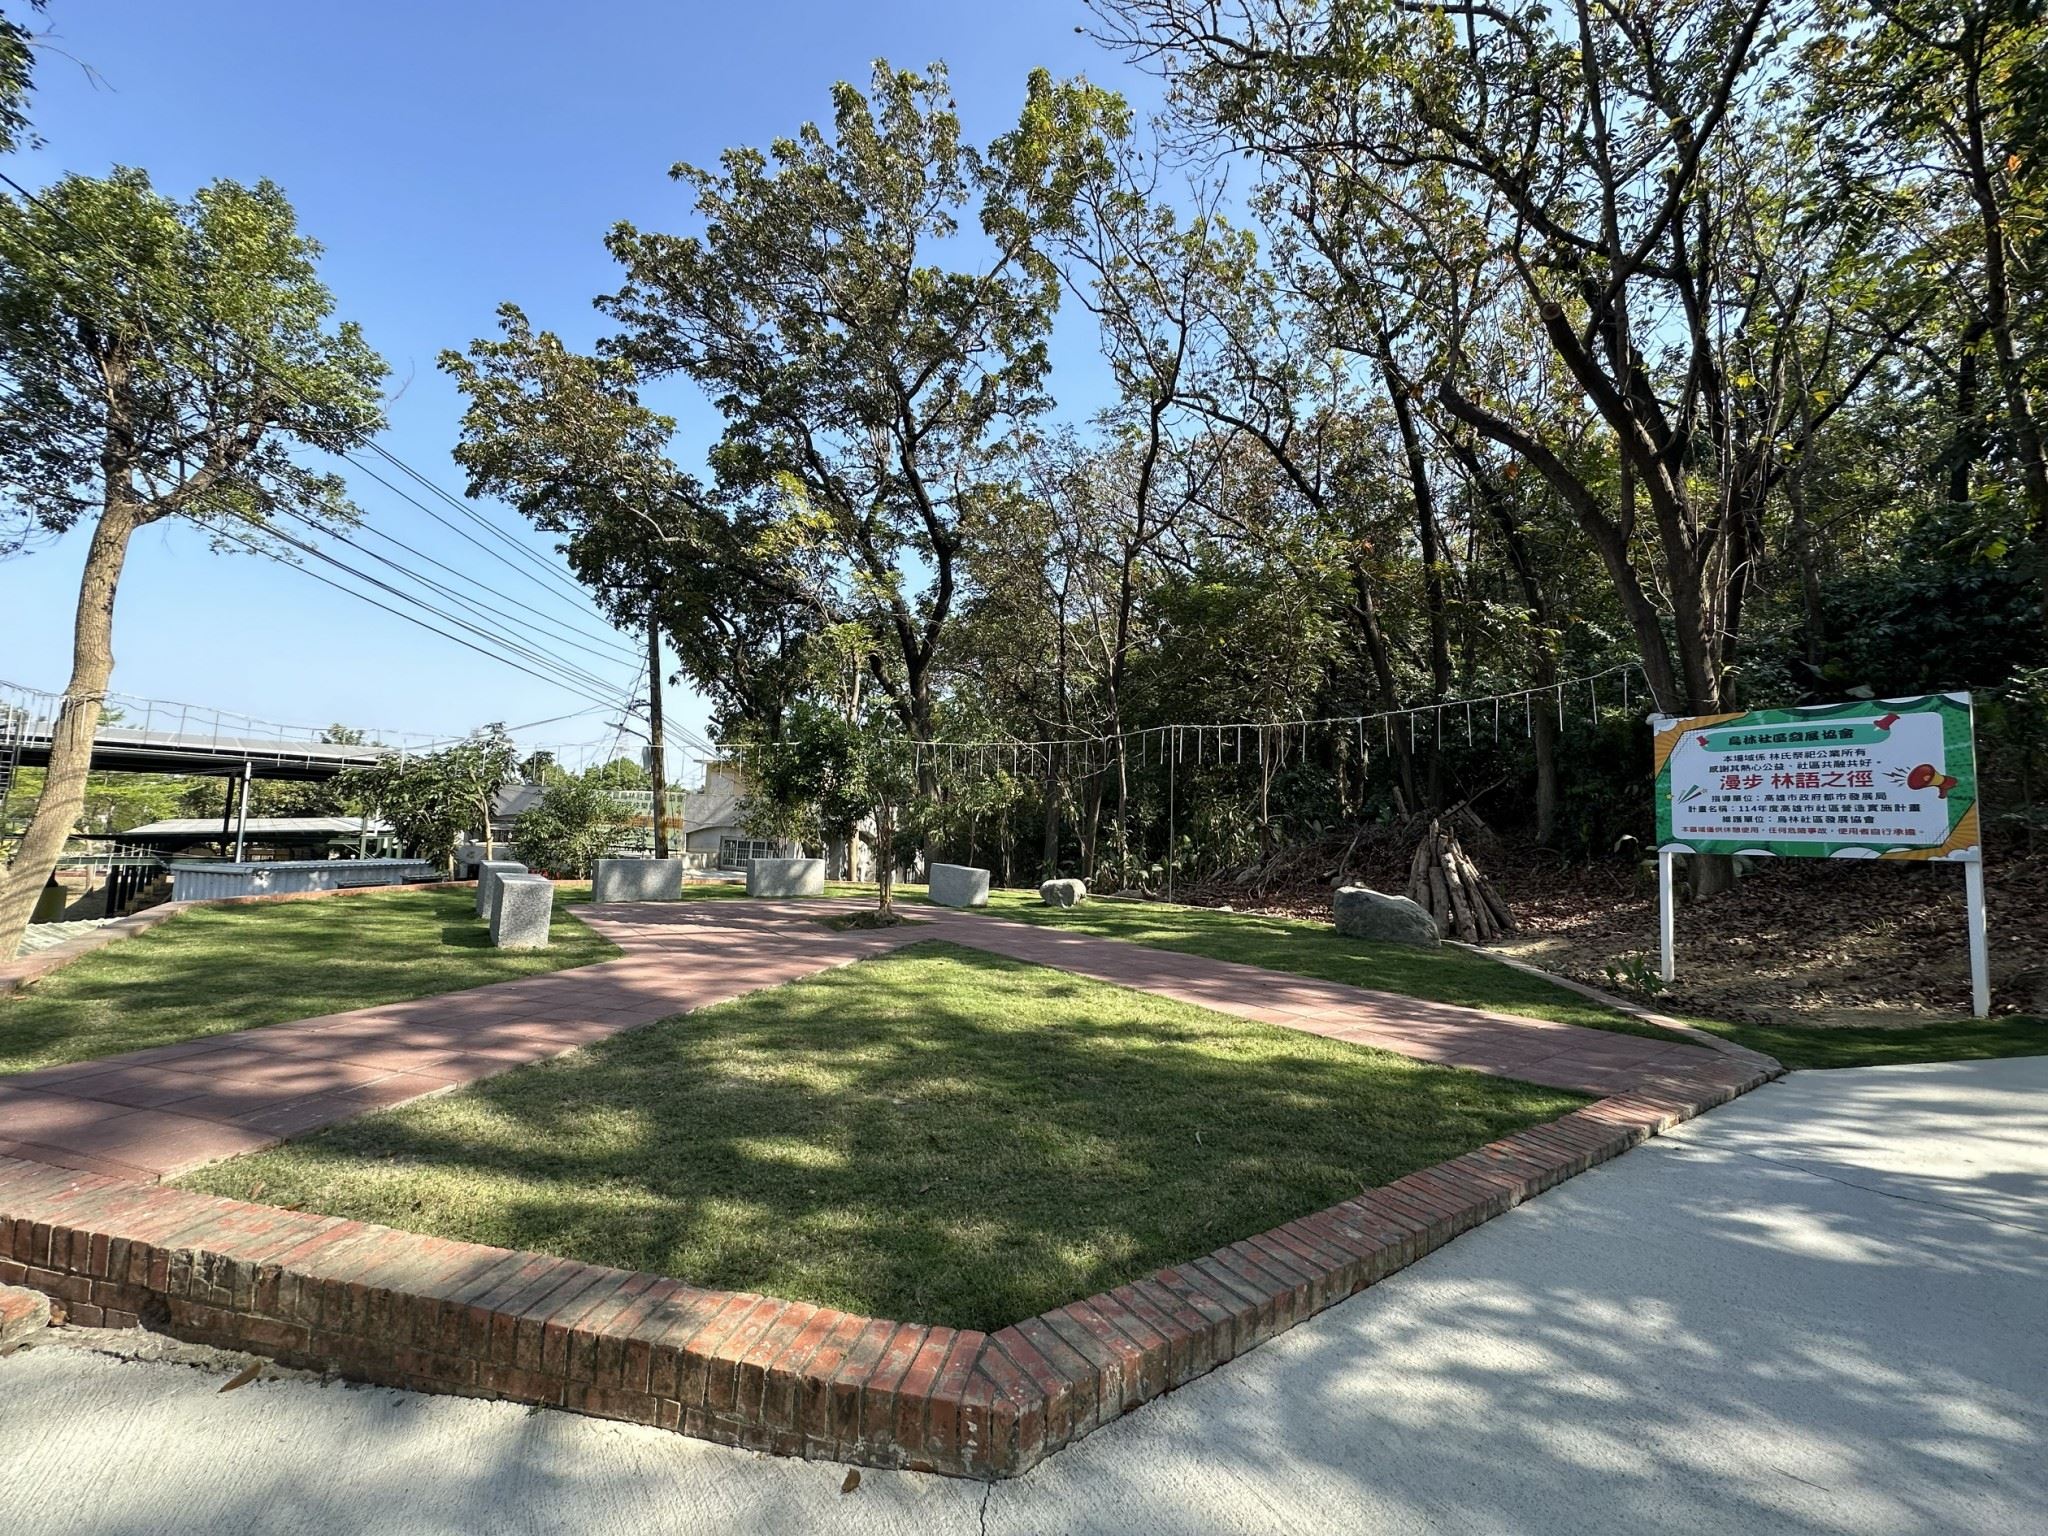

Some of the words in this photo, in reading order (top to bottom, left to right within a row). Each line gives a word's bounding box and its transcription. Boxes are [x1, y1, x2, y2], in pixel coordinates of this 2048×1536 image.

[1720, 773, 1764, 790] 漫步
[1771, 770, 1875, 789] 林語之徑
